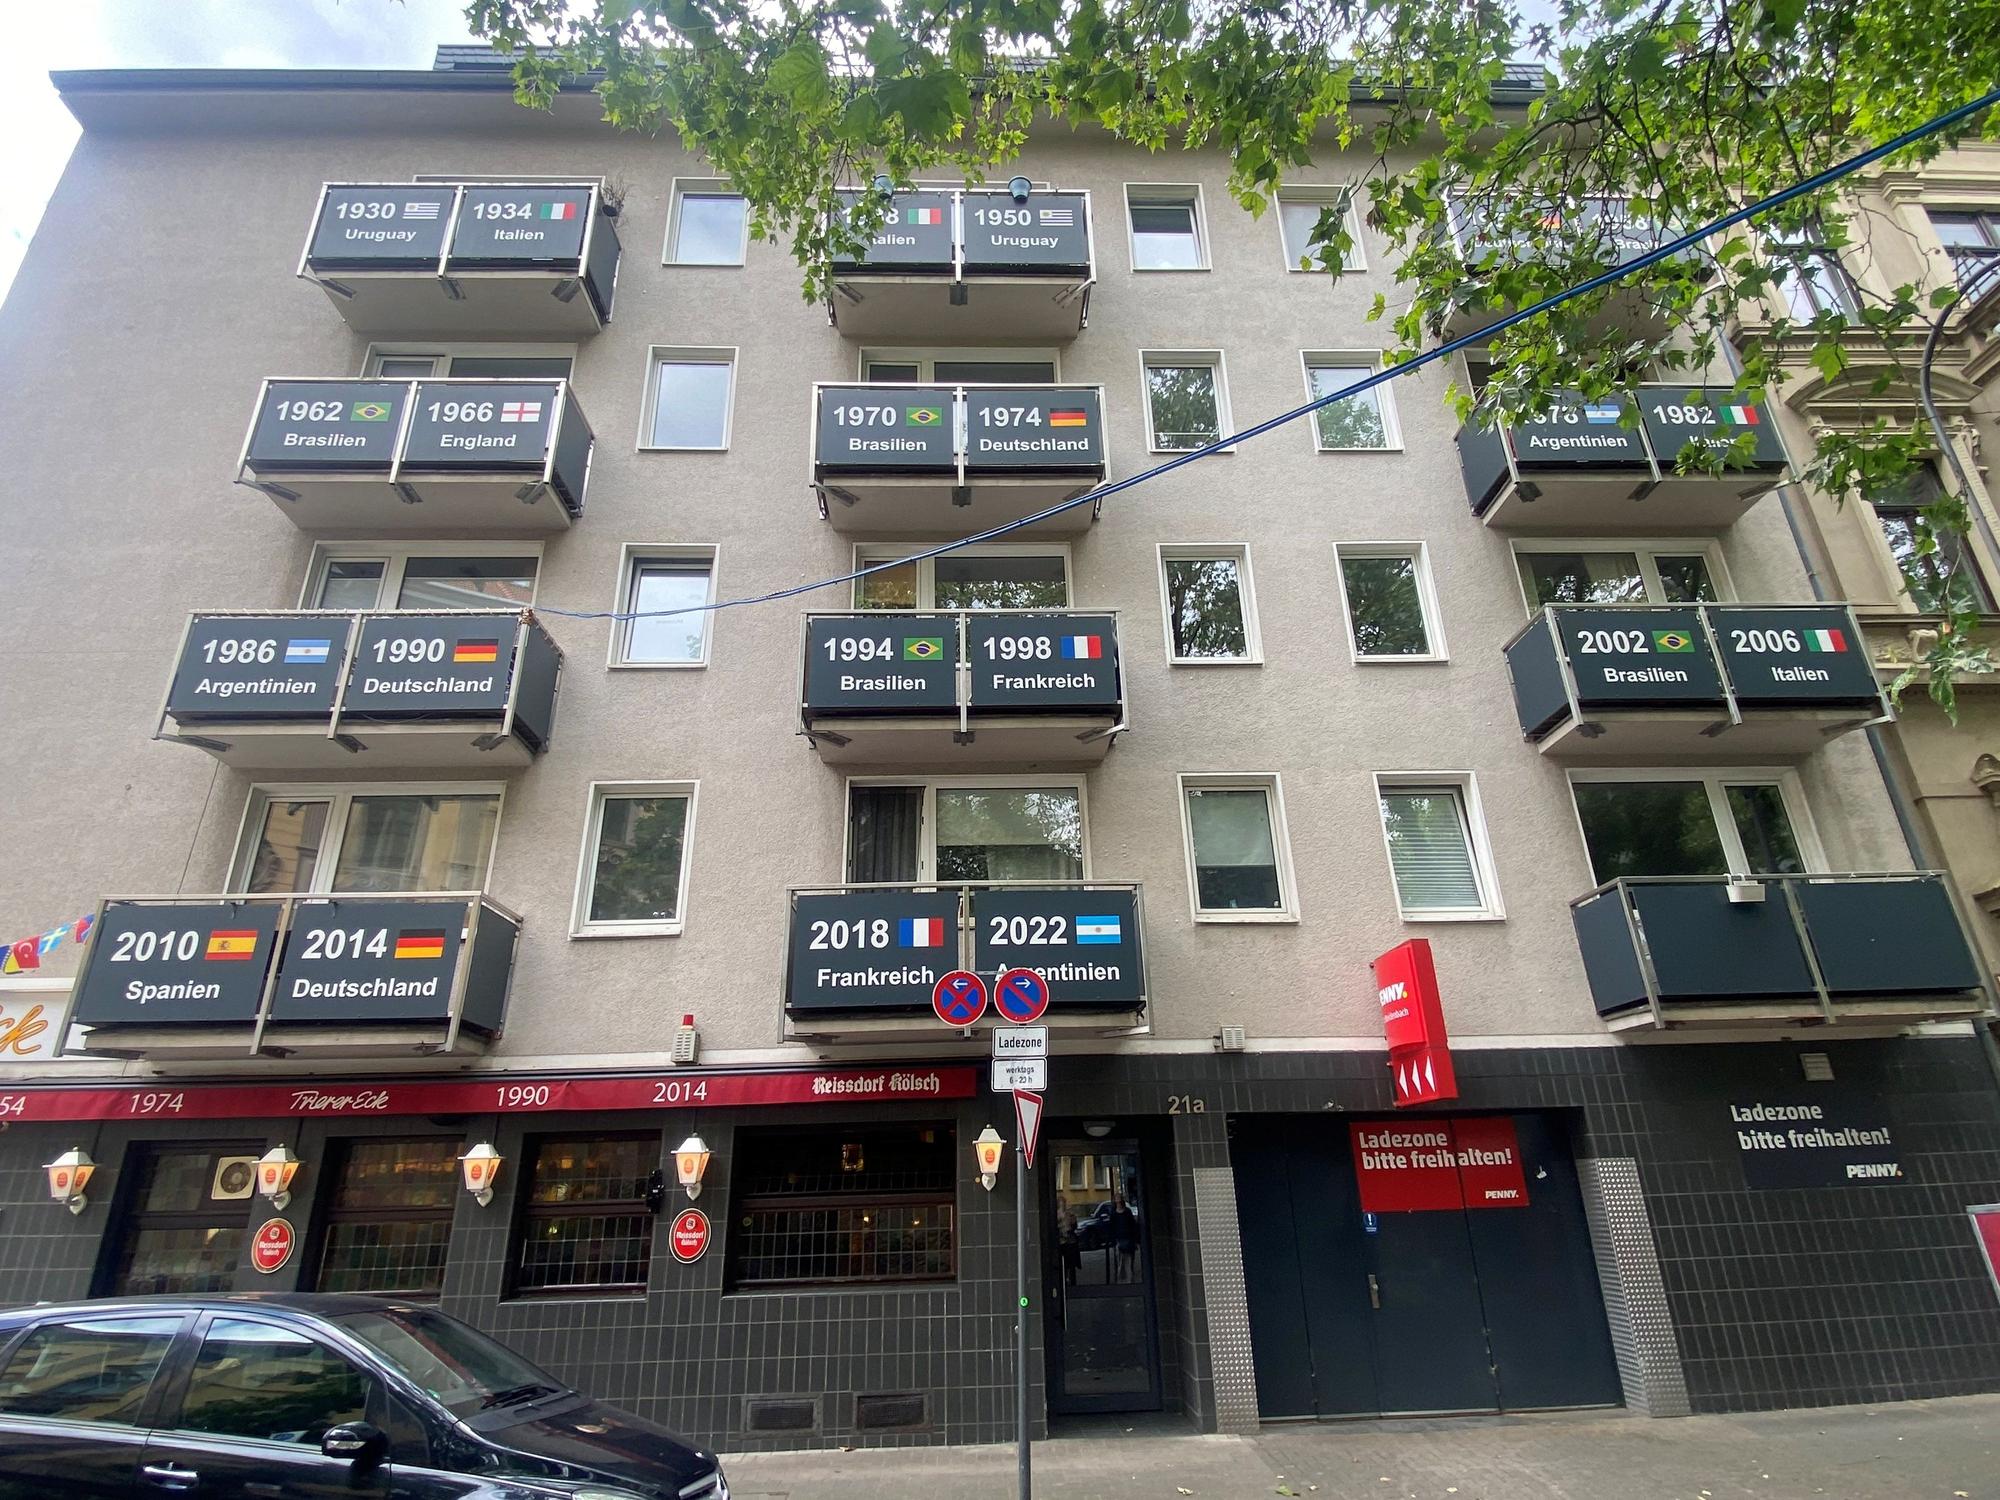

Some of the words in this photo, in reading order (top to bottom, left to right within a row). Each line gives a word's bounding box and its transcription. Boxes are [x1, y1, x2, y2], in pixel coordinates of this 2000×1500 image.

[336, 202, 396, 220] 1930
[472, 202, 532, 220] 1934
[974, 208, 1032, 226] 1950
[345, 228, 417, 243] Uruguay
[494, 228, 545, 241] Italien
[872, 233, 916, 245] talien
[991, 234, 1059, 248] Uruguay
[276, 401, 342, 422] 1962
[427, 401, 493, 423] 1966
[833, 406, 897, 427] 1970
[978, 407, 1042, 427] 1974
[1653, 405, 1717, 424] 1982
[284, 433, 367, 448] Brasilien
[440, 434, 516, 451] England
[849, 437, 927, 452] Brasilien
[979, 437, 1089, 452] Deutschland
[1529, 434, 1628, 451] Argentinien
[372, 638, 446, 663] 1990
[823, 637, 894, 661] 1994
[983, 636, 1052, 660] 1998
[1577, 630, 1650, 654] 2002
[1730, 629, 1801, 653] 2006
[202, 639, 277, 664] 1986
[840, 675, 926, 691] Brasilien
[993, 673, 1096, 690] Frankreich
[1603, 666, 1688, 683] Brasilien
[1772, 666, 1829, 682] Italien
[195, 678, 317, 695] Argentinien
[363, 677, 493, 694] Deutschland
[809, 917, 889, 950] 2018
[989, 915, 1068, 946] 2022
[110, 930, 199, 963] 2010
[301, 928, 388, 960] 2014
[817, 965, 935, 988] Frankreich
[995, 962, 1121, 983] Aentinien
[125, 980, 221, 1004] Spanien
[292, 977, 438, 999] Deutschland
[999, 1036, 1042, 1048] Ladezone
[1006, 1066, 1035, 1075] werktags
[653, 1081, 708, 1103] 2014
[812, 1075, 885, 1095] Reissdorf
[889, 1072, 940, 1094] Kölsch
[129, 1093, 184, 1113] 1974
[352, 1090, 389, 1109] Eck
[496, 1085, 550, 1107] 1990
[1168, 1095, 1205, 1114] 21a
[1730, 1103, 1823, 1123] Ladezone
[1358, 1130, 1448, 1149] Ladezone
[1737, 1130, 1786, 1150] bitte
[1788, 1127, 1891, 1148] freihalten!
[1362, 1151, 1407, 1170] bitte
[1410, 1148, 1513, 1168] freihalten!
